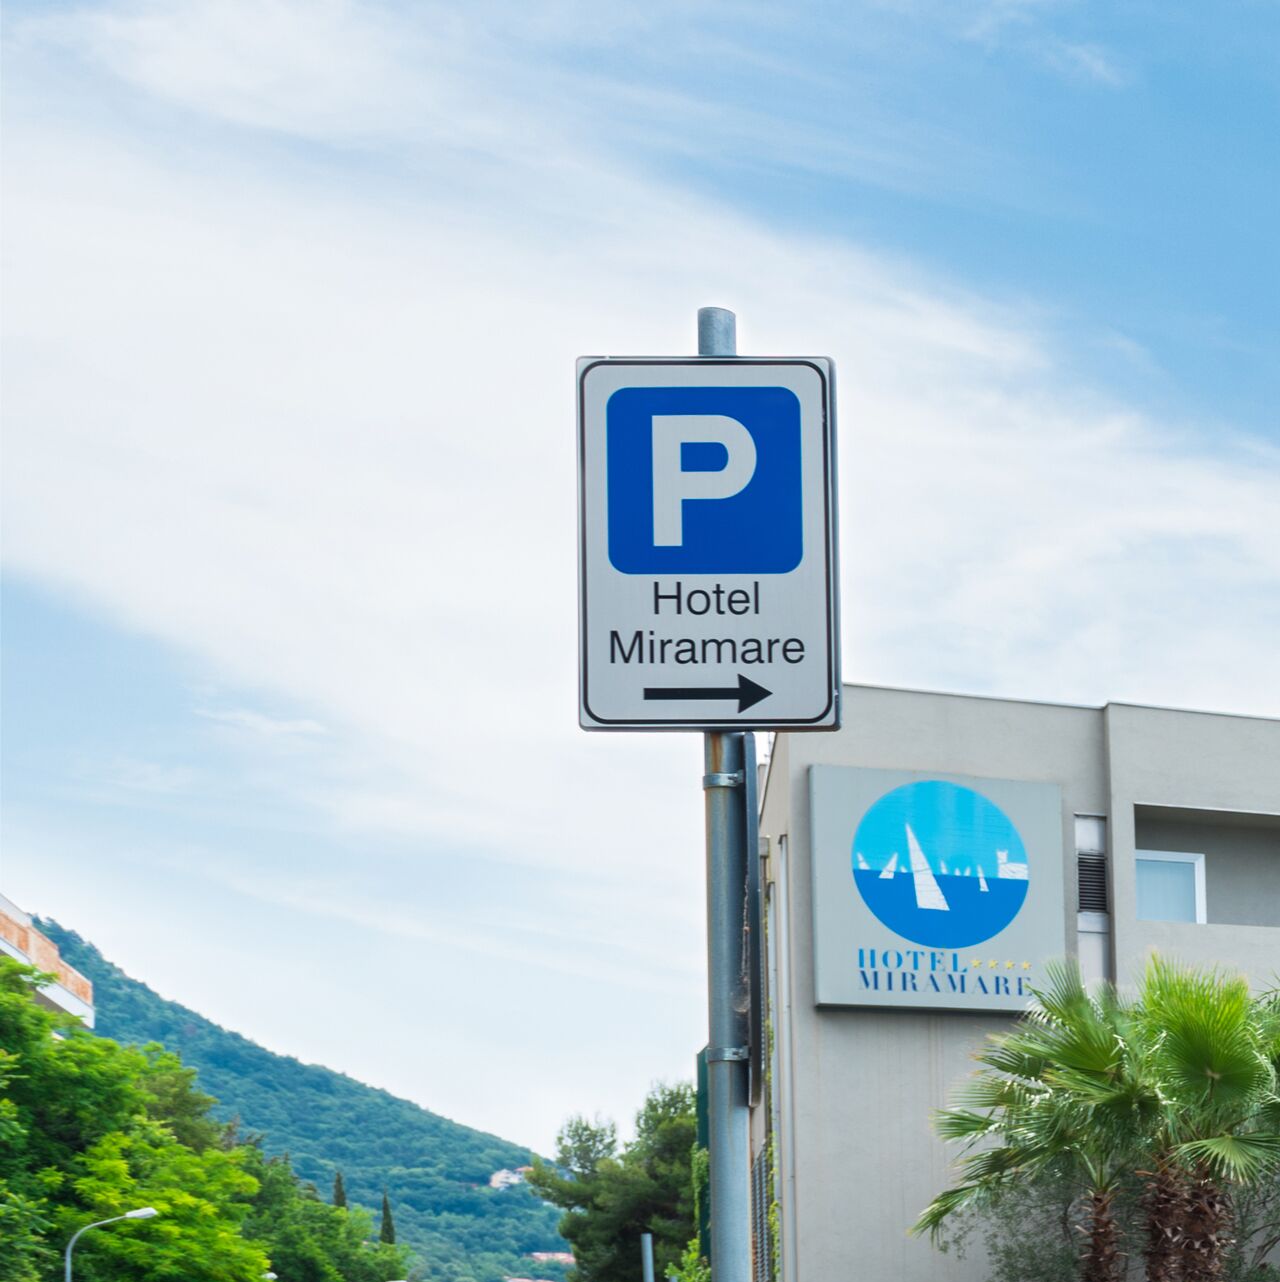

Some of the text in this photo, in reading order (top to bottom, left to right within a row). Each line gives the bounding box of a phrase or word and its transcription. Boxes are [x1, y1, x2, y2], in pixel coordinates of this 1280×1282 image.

[652, 415, 757, 546] P
[653, 581, 760, 615] Hotel
[609, 631, 806, 664] Miramare
[858, 948, 968, 973] HOTEL
[858, 970, 1034, 997] MIRAMARE
